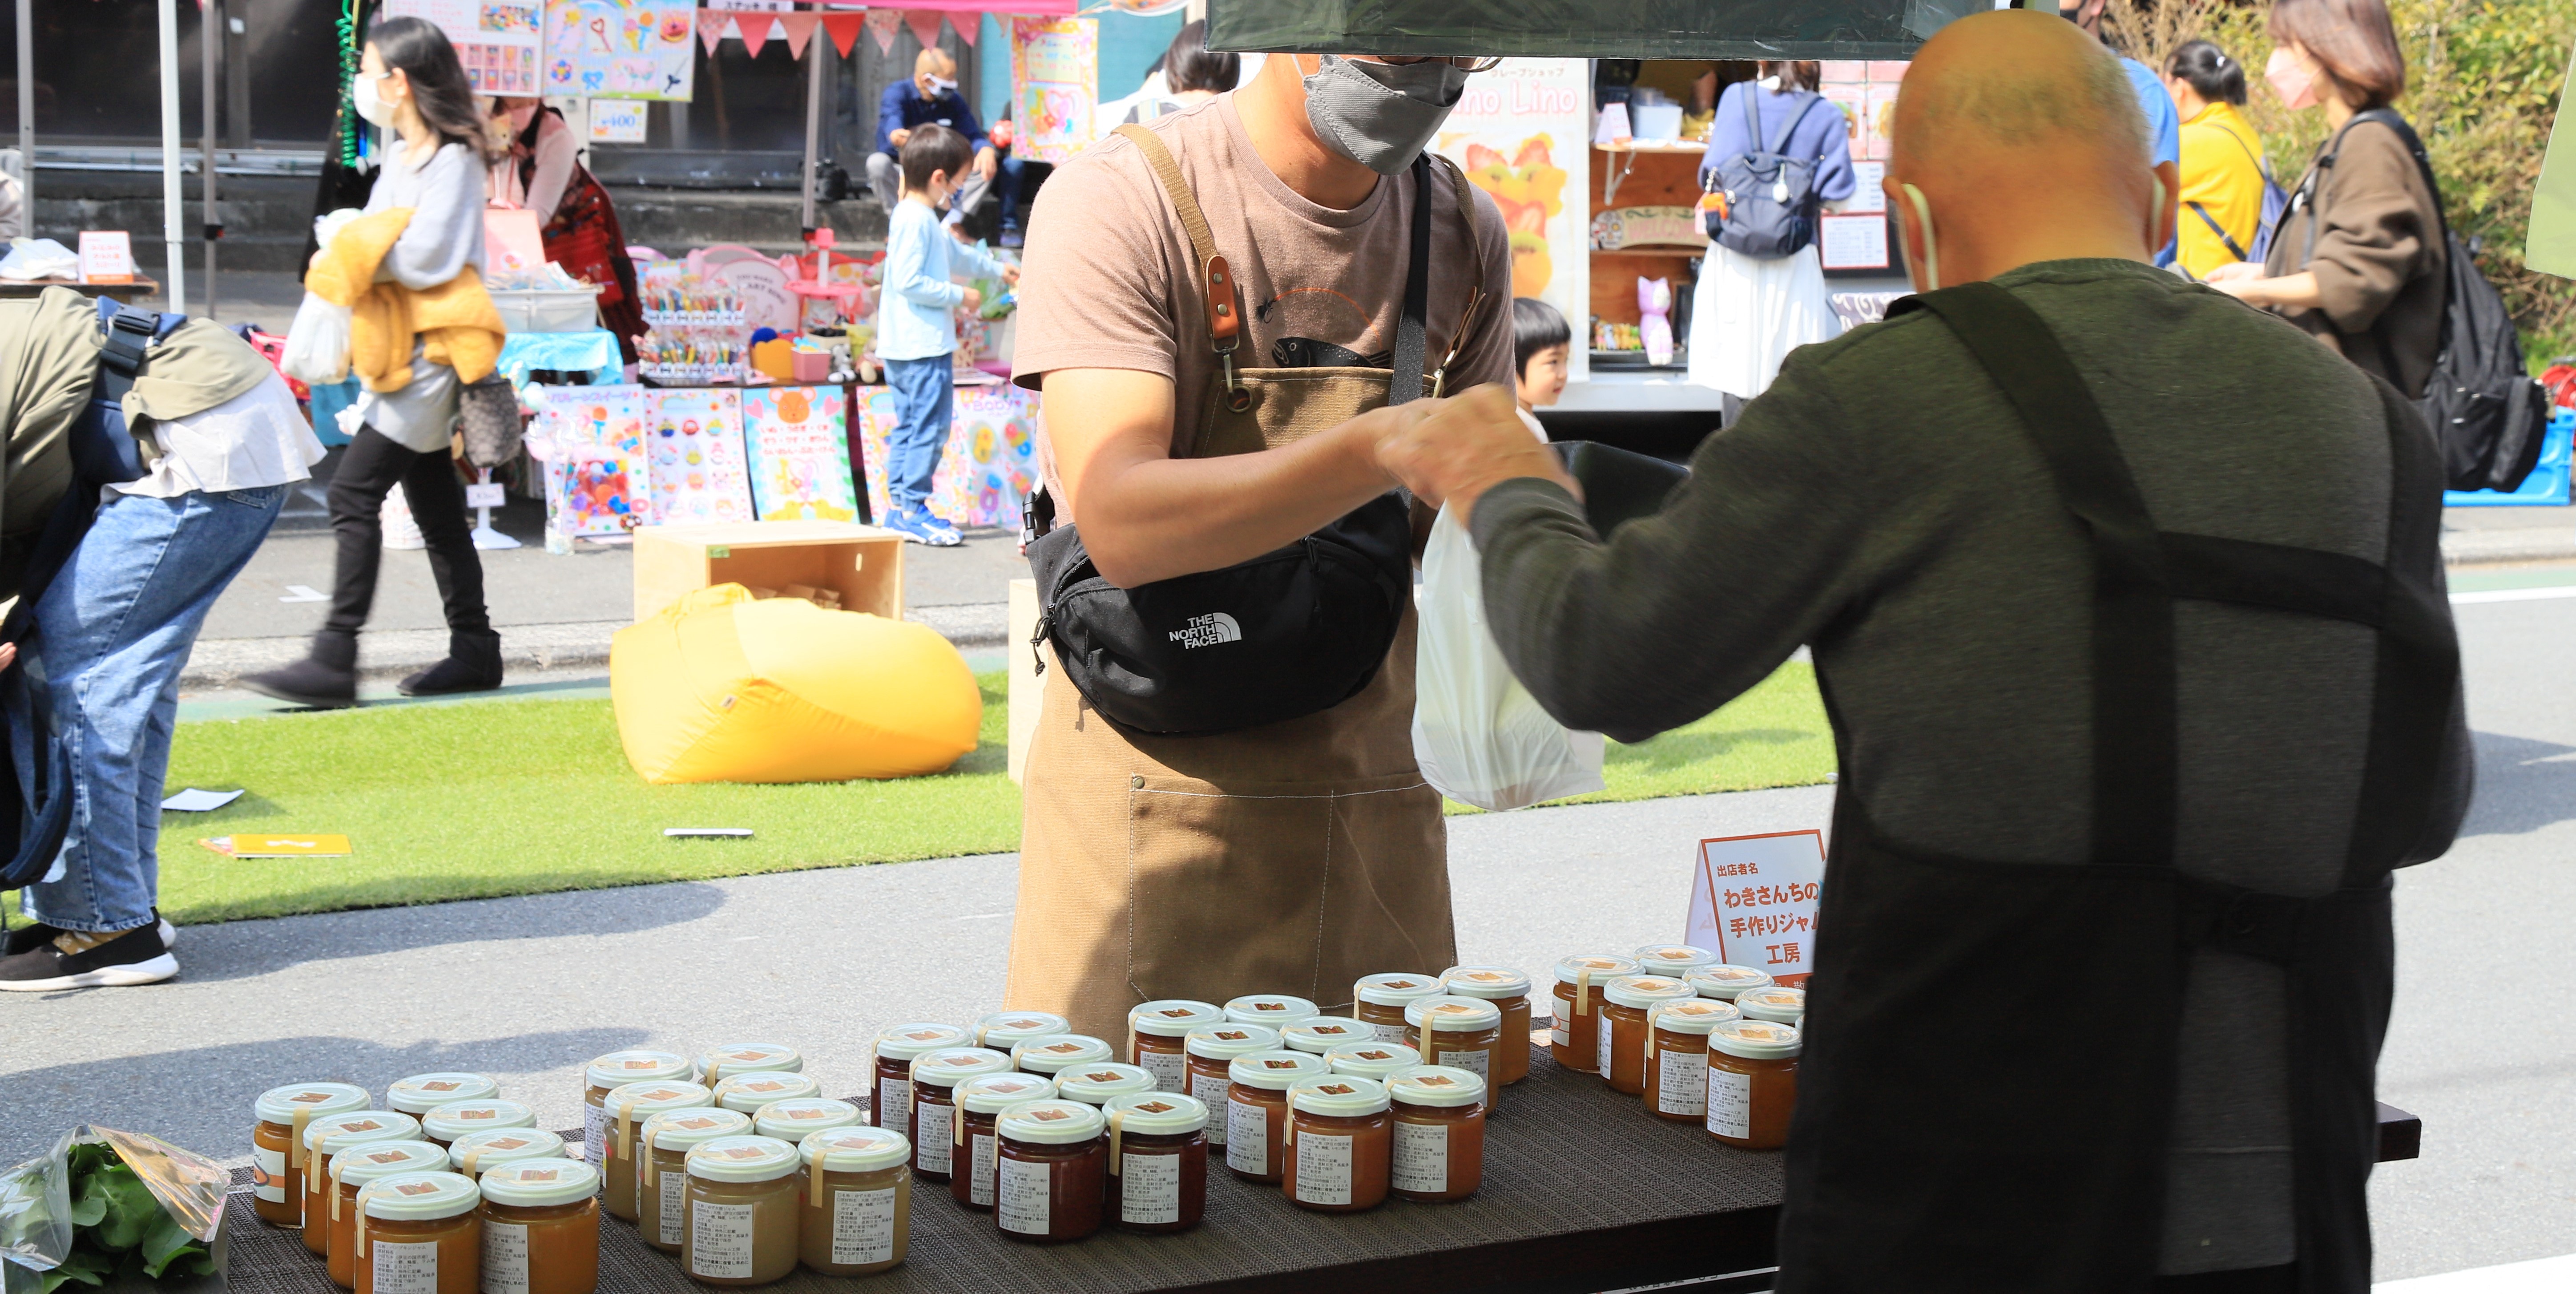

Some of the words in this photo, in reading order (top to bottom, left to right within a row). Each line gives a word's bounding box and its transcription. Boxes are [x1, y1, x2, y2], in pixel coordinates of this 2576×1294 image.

[1510, 79, 1577, 115] Lino
[1187, 614, 1213, 627] THE
[1169, 624, 1216, 641] NORTH
[1184, 634, 1217, 650] FACE
[1717, 862, 1758, 877] 出店者名
[1724, 882, 1818, 908] わきさんちの
[1766, 942, 1800, 964] 工房
